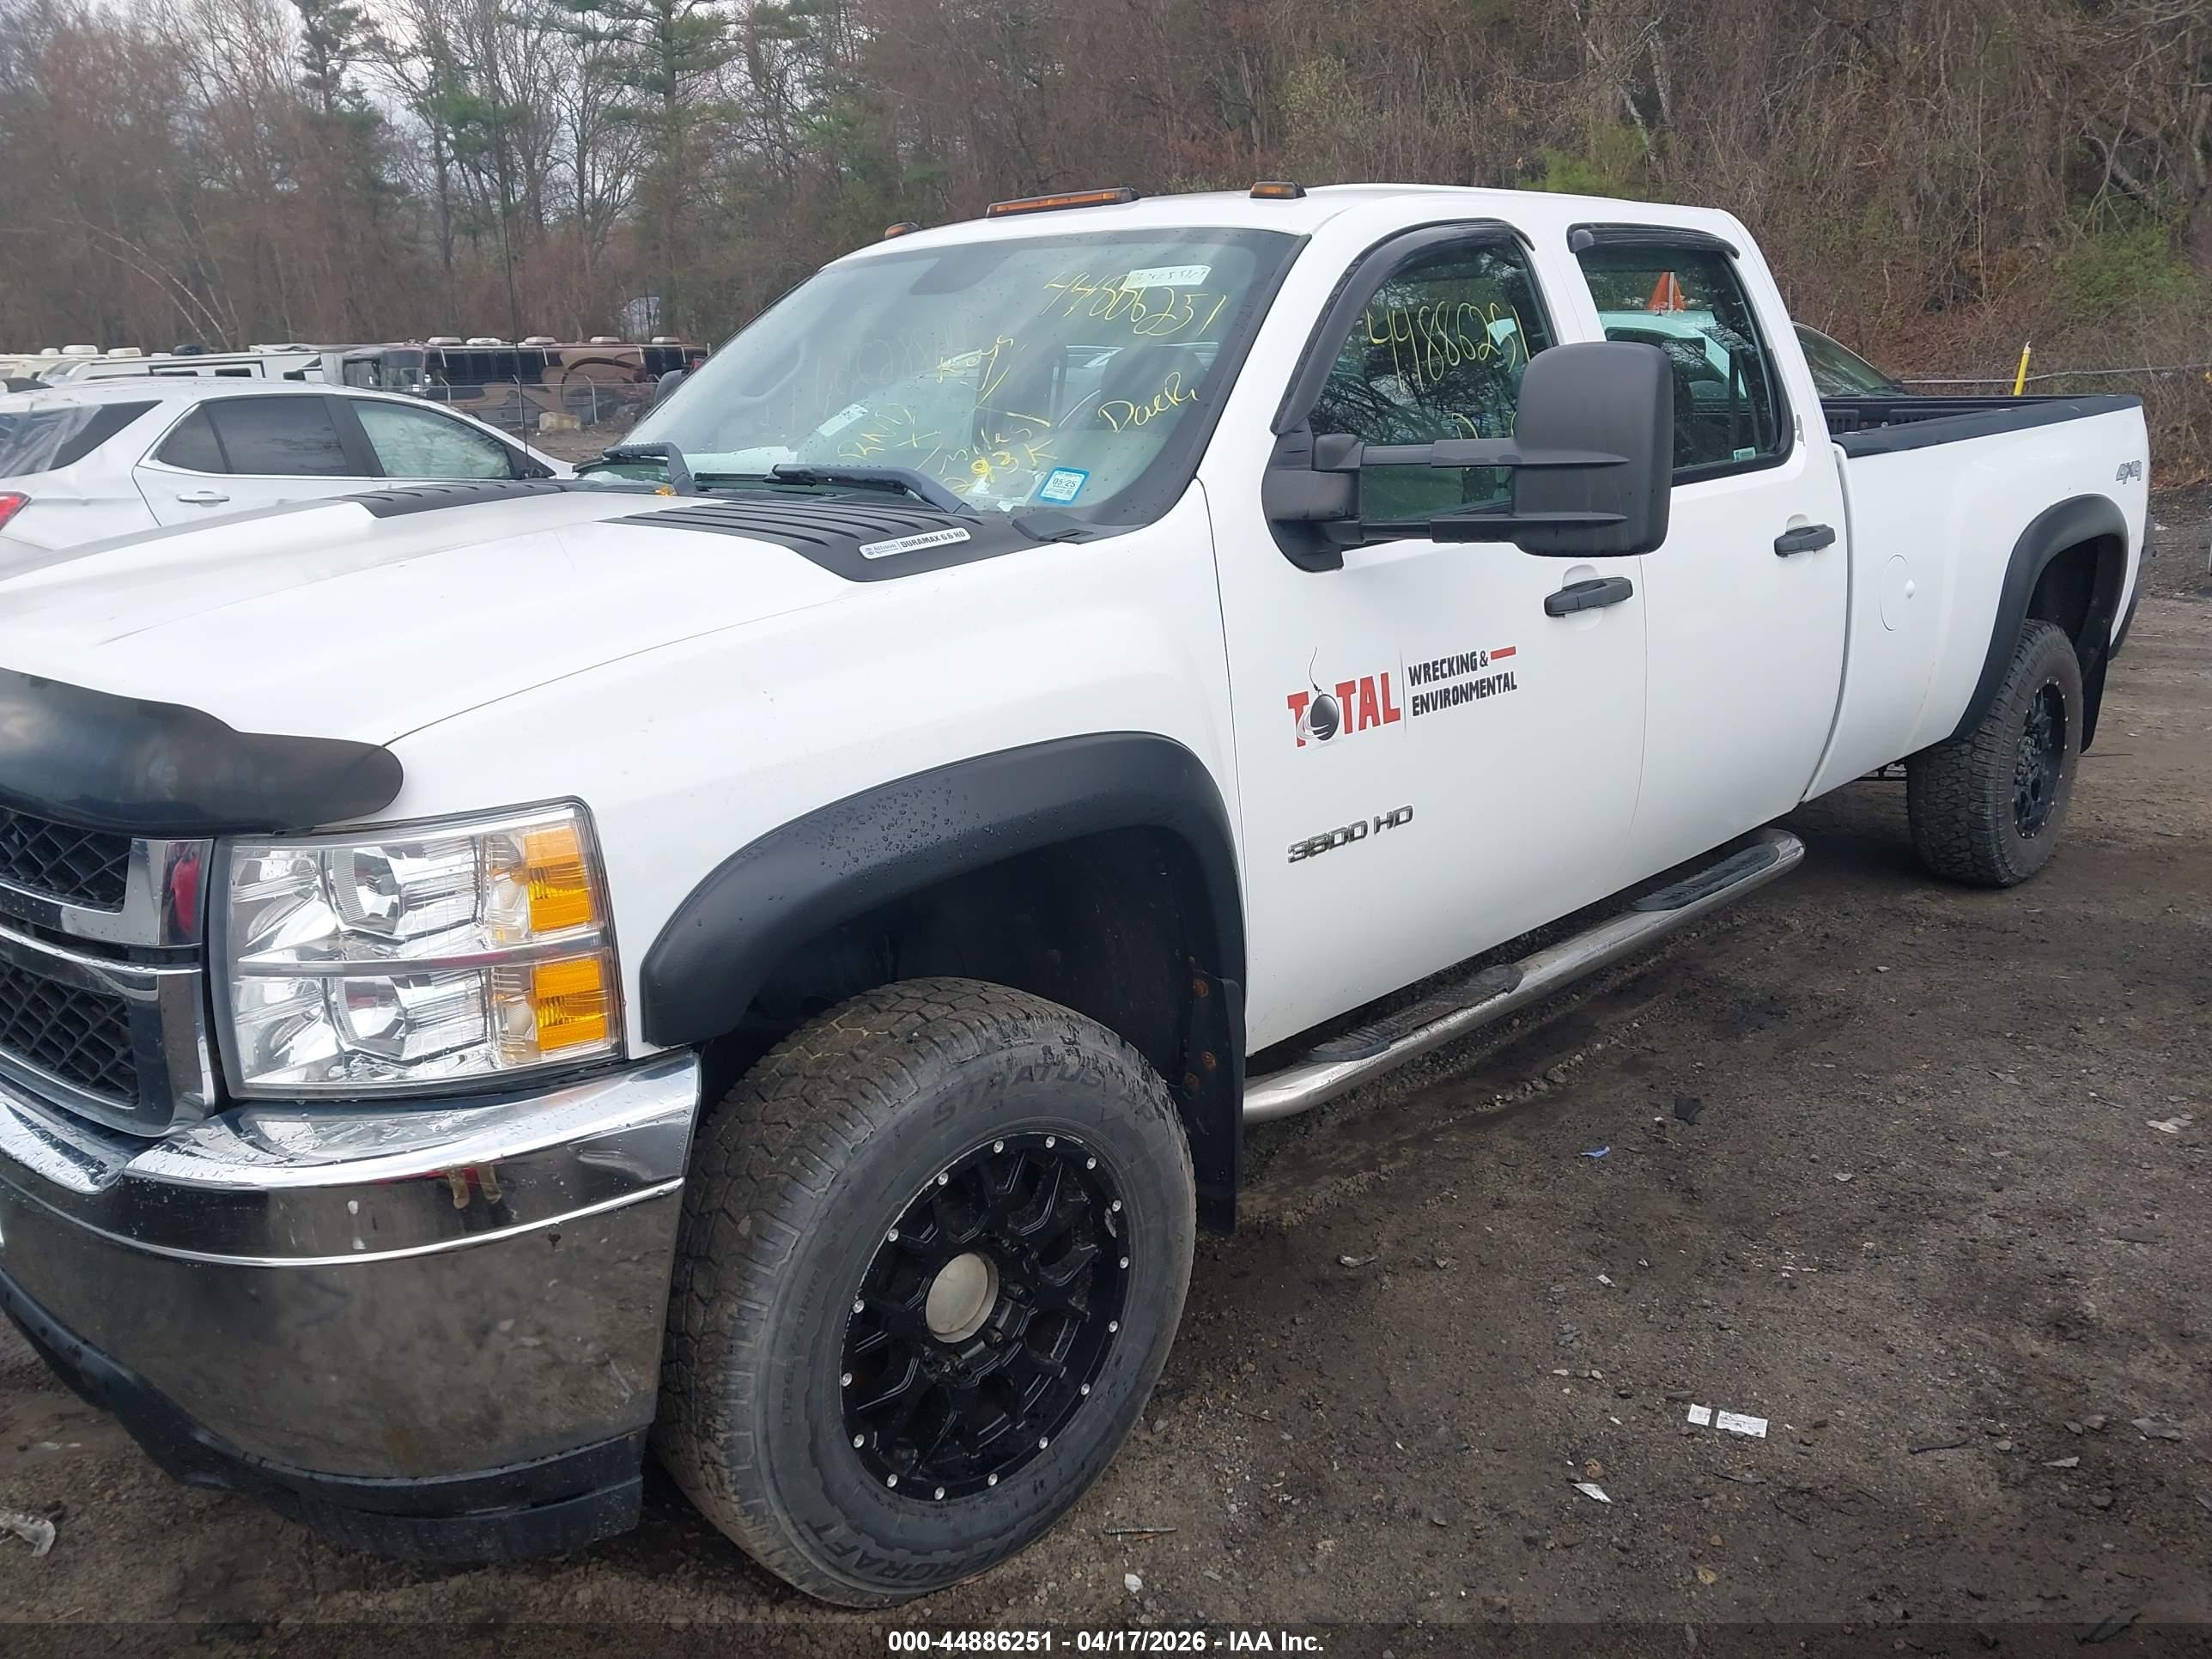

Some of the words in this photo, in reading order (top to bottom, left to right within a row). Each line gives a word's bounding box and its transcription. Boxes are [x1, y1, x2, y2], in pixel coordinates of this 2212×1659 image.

[1365, 301, 1532, 393] 44886251
[900, 535, 940, 548] DURAMAX
[1408, 651, 1478, 687] WRECKING
[1479, 650, 1489, 668] &
[1411, 671, 1518, 717] ENVIRONMENTAL
[1287, 672, 1401, 748] TOTAL
[1287, 820, 1368, 864] 3500
[1374, 805, 1413, 835] HD
